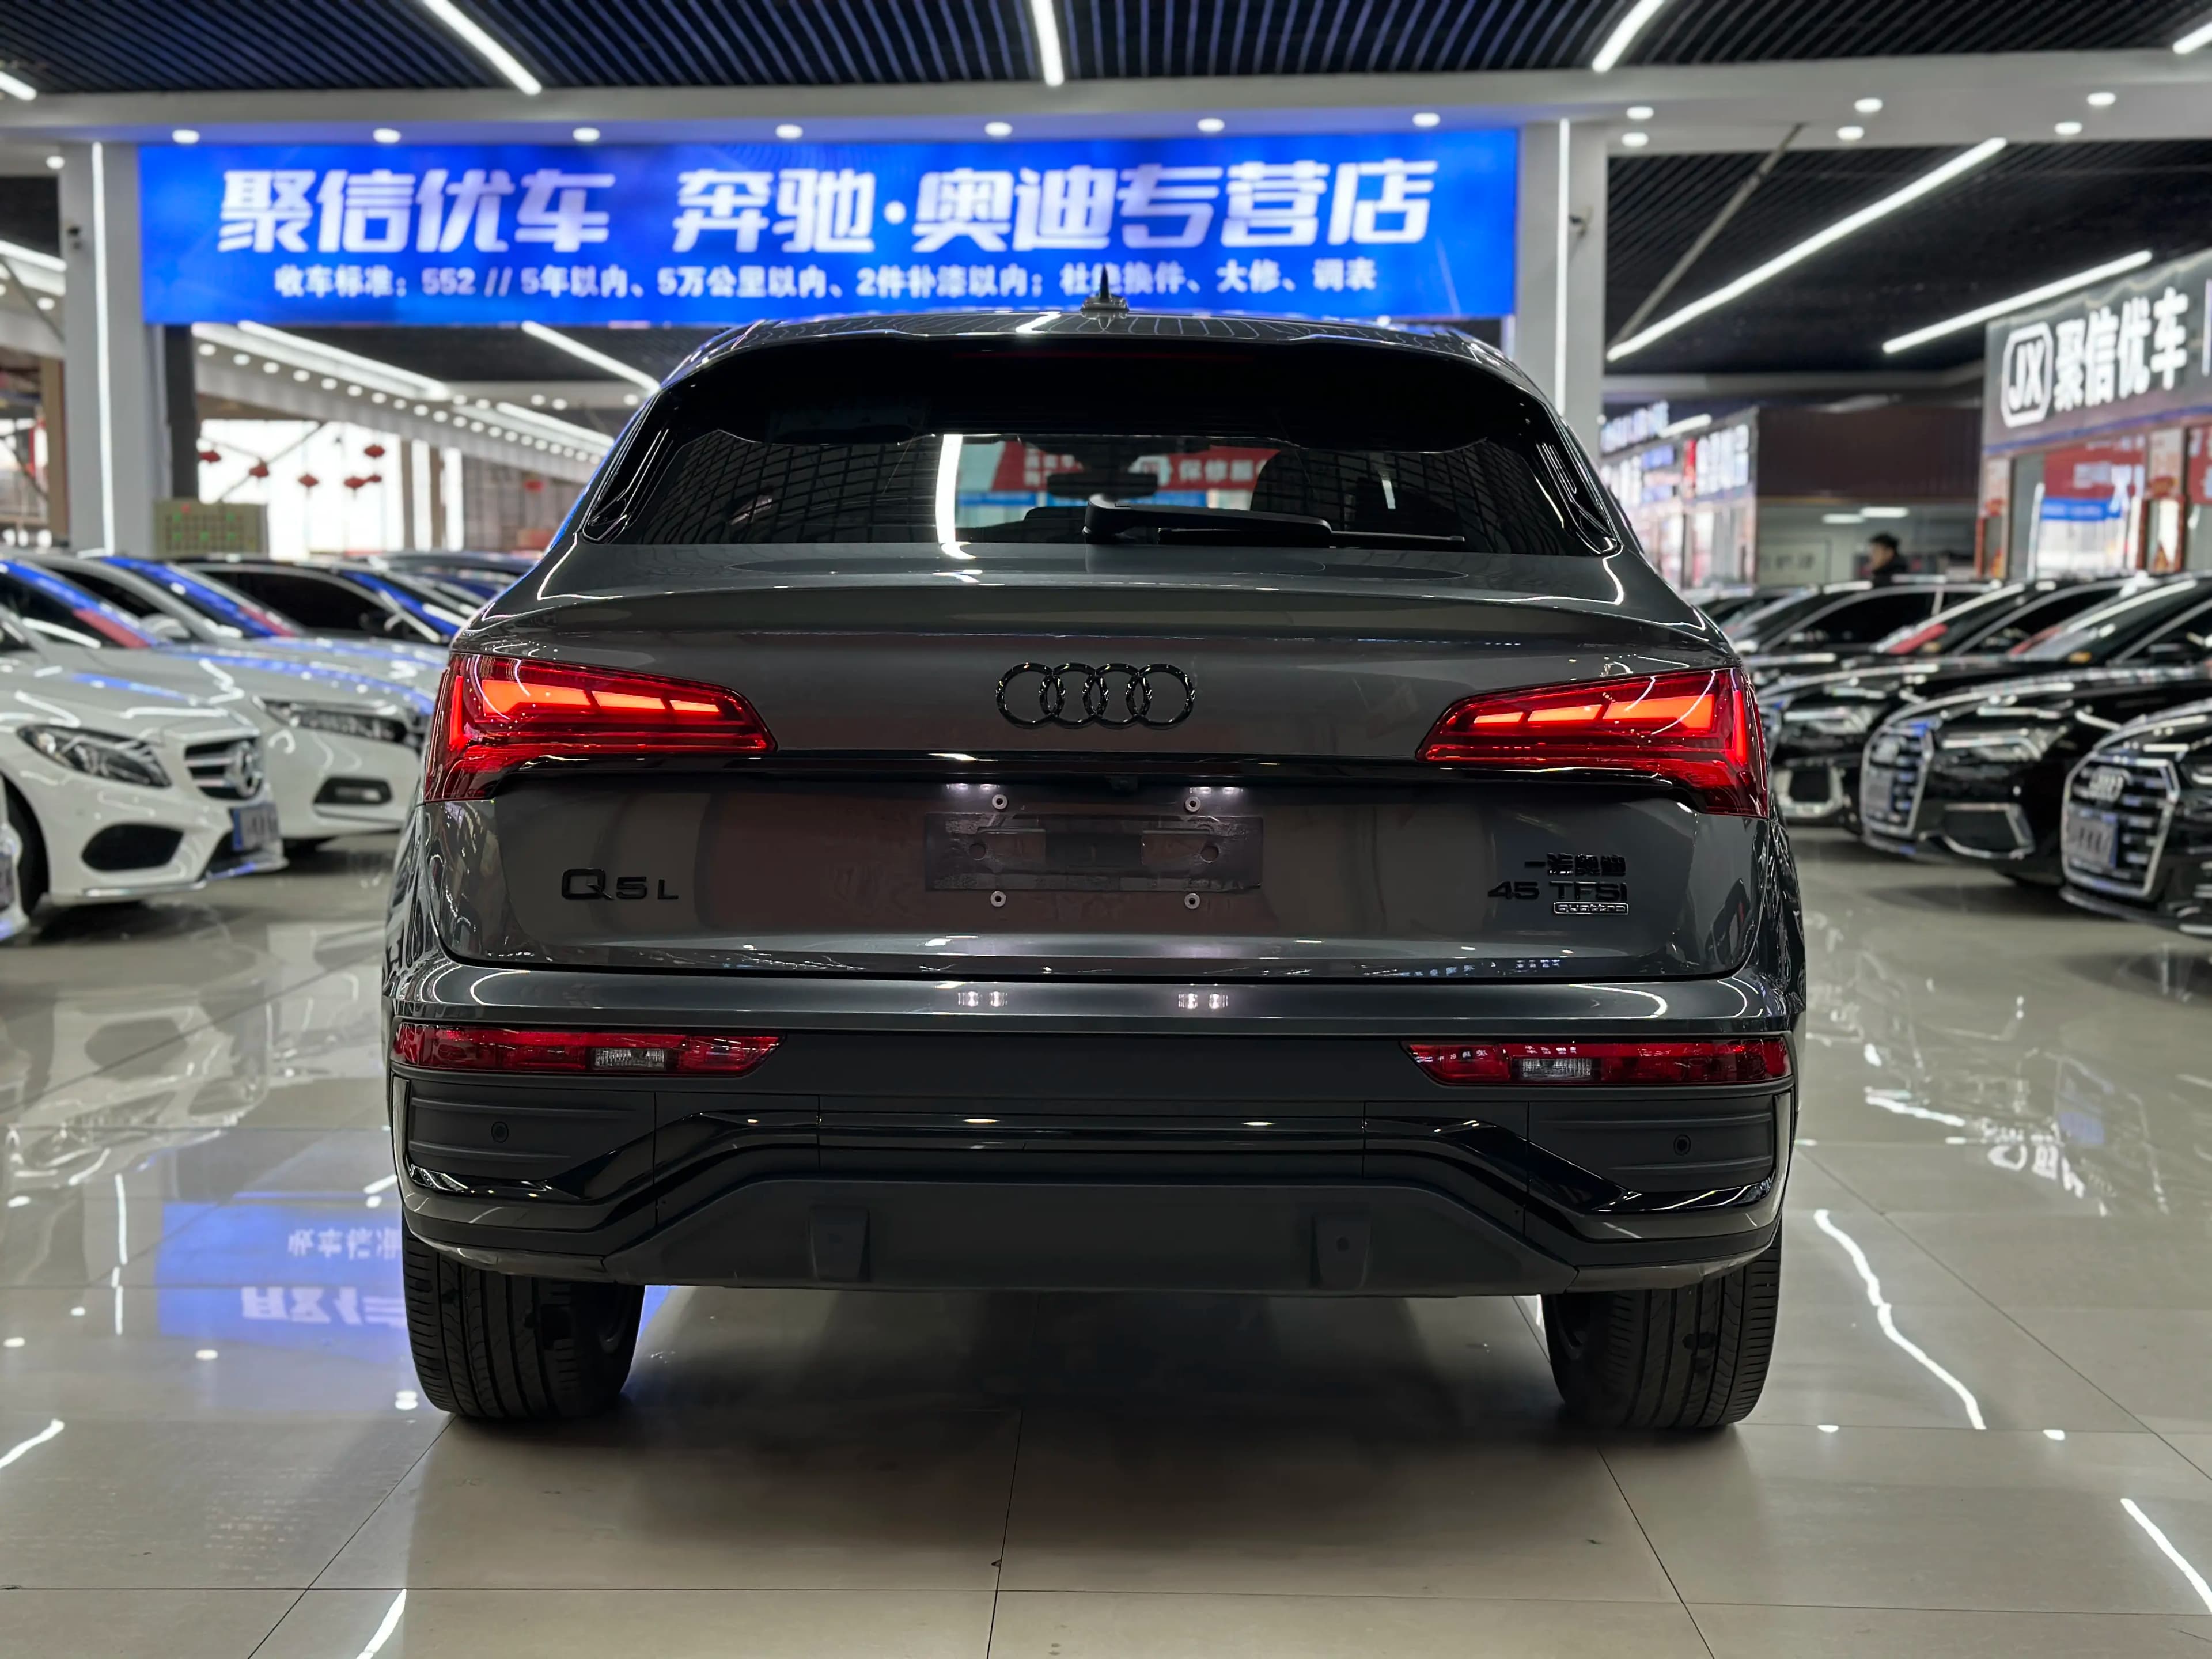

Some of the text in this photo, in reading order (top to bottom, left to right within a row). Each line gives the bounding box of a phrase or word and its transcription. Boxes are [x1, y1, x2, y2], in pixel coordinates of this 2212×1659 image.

[217, 158, 1439, 253] 聚信优车 奔驰·奥迪专营店
[2009, 340, 2044, 410] JX
[2054, 286, 2189, 412] 聚信优车
[1488, 881, 1627, 900] 45 TFSI
